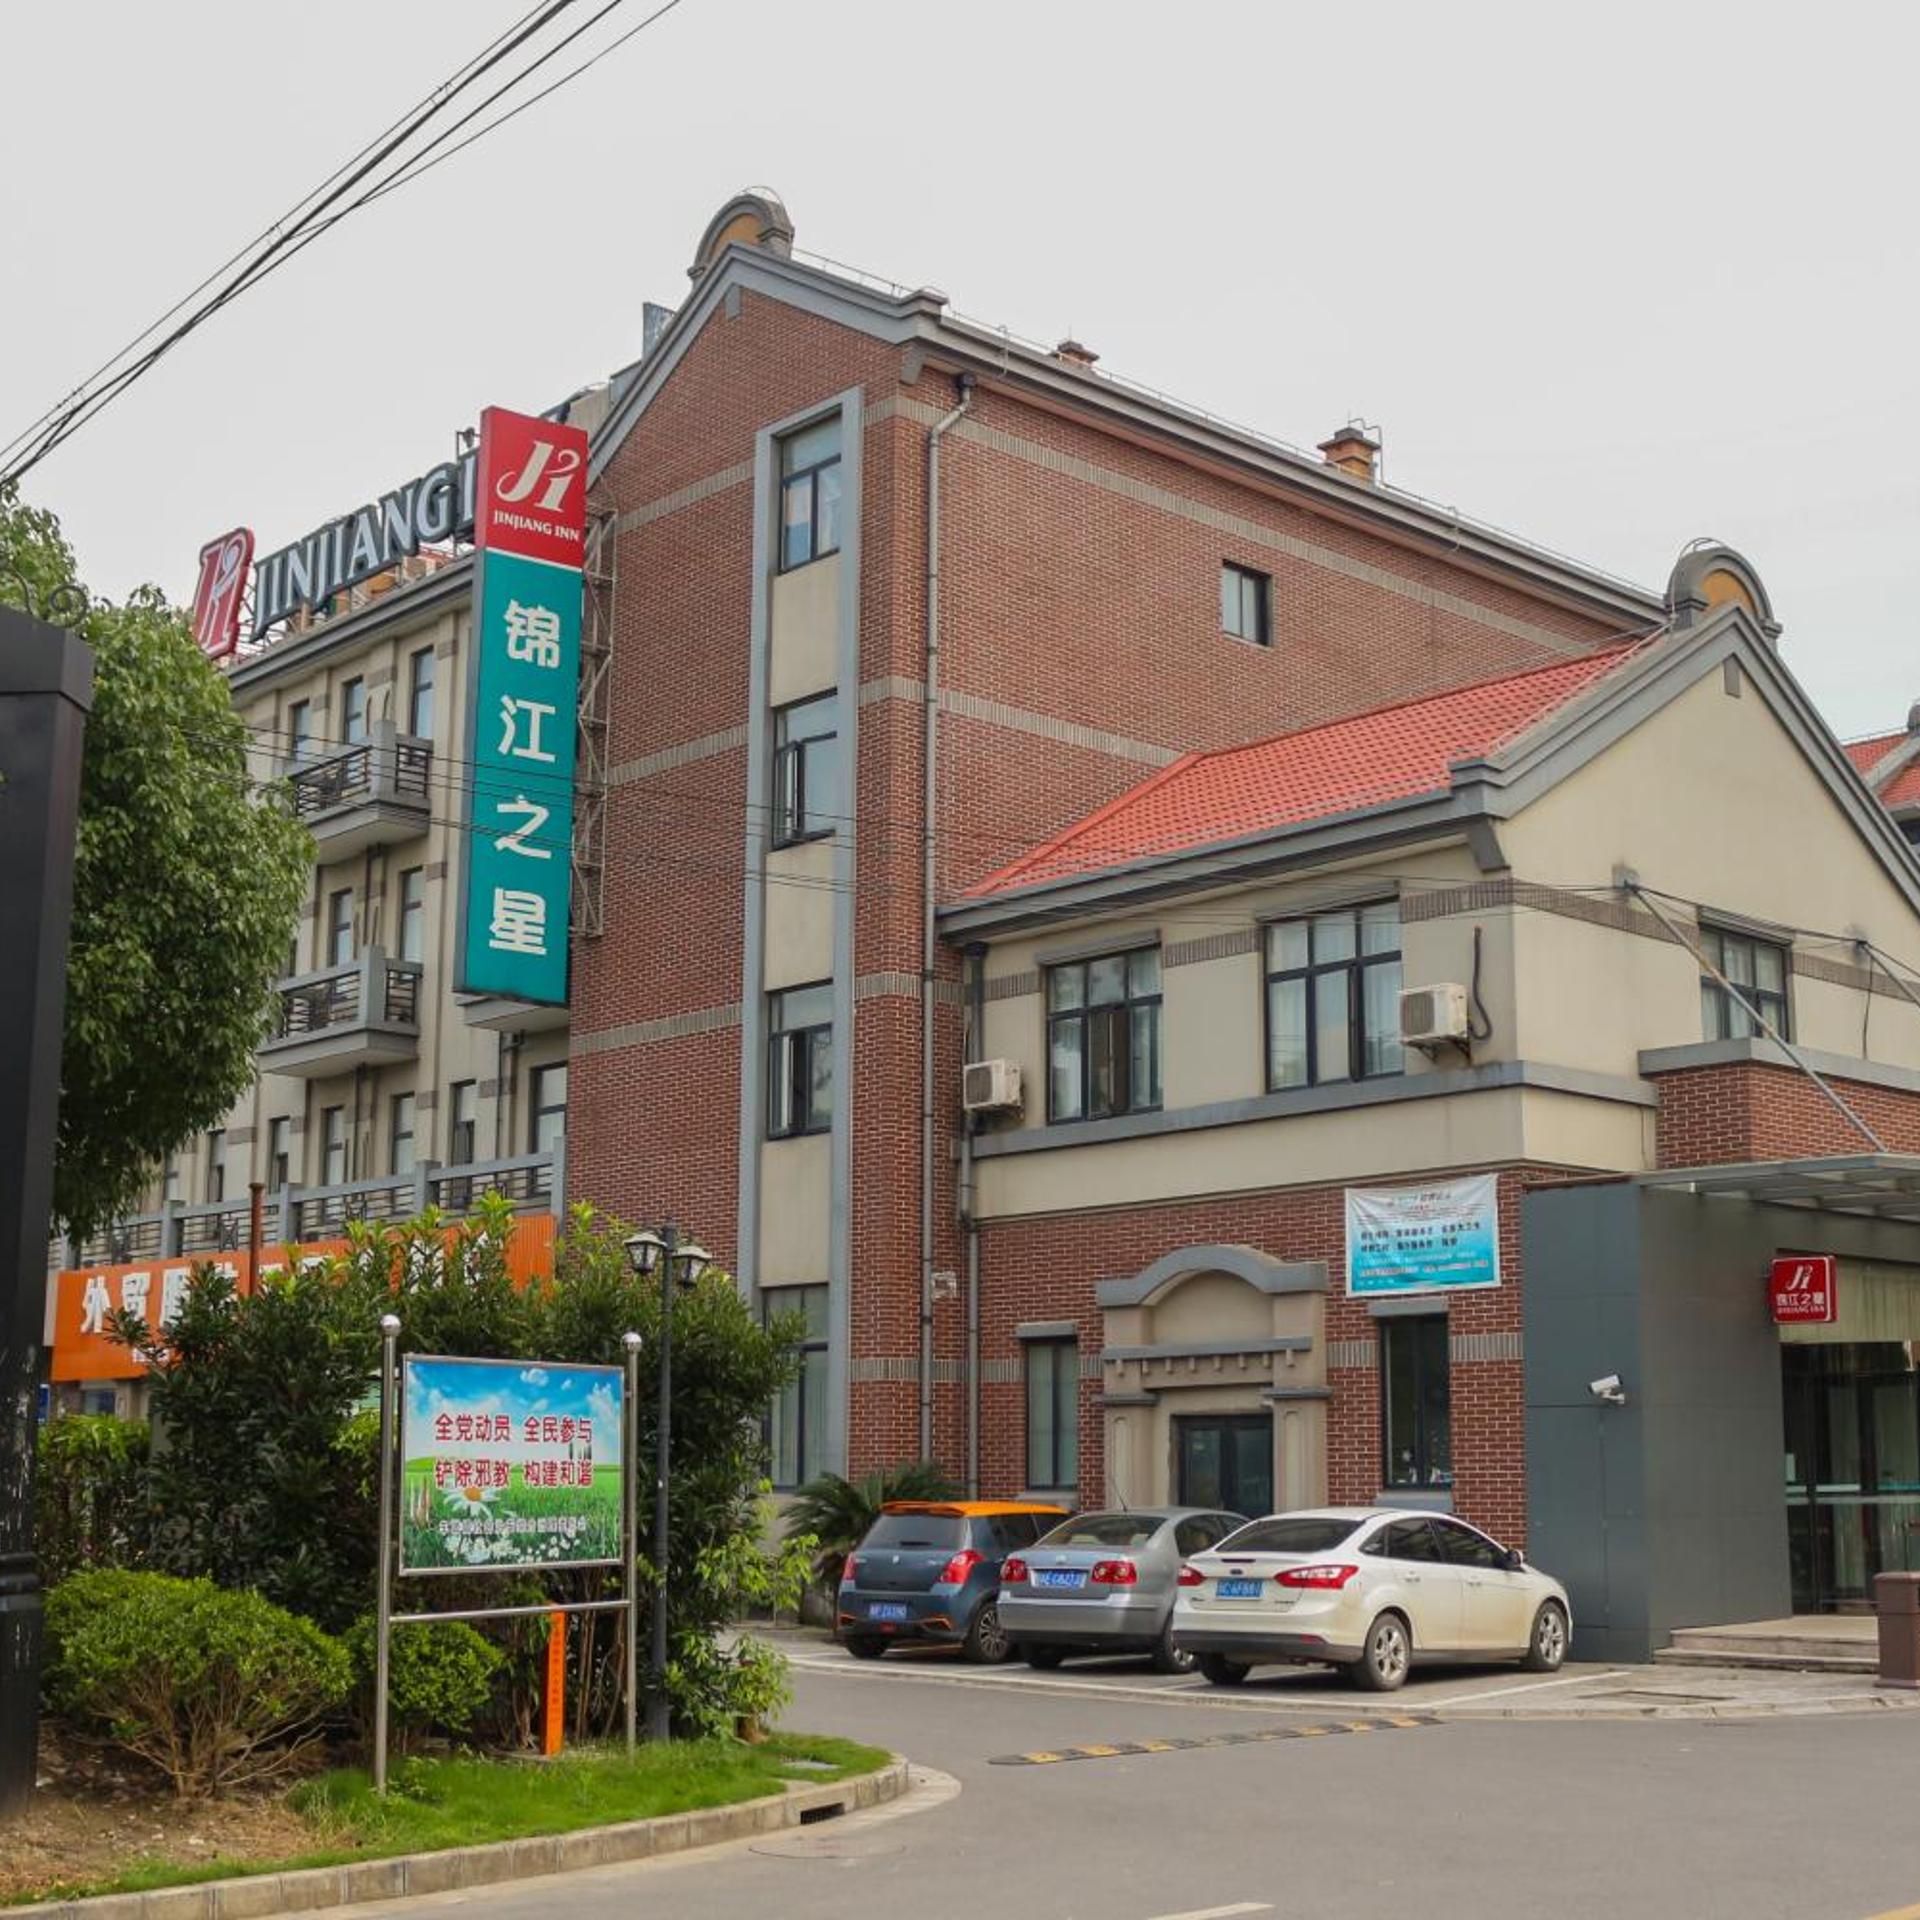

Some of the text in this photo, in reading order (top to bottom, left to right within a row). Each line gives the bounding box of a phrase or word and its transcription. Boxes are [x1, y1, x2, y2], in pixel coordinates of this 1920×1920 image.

[493, 509, 580, 542] JINJIANG INN
[253, 465, 454, 636] JINJIANG
[487, 598, 561, 956] 锦江之星
[435, 1412, 592, 1443] 全党动员 全民参与
[435, 1459, 593, 1487] 铲除邪教 构建和谐
